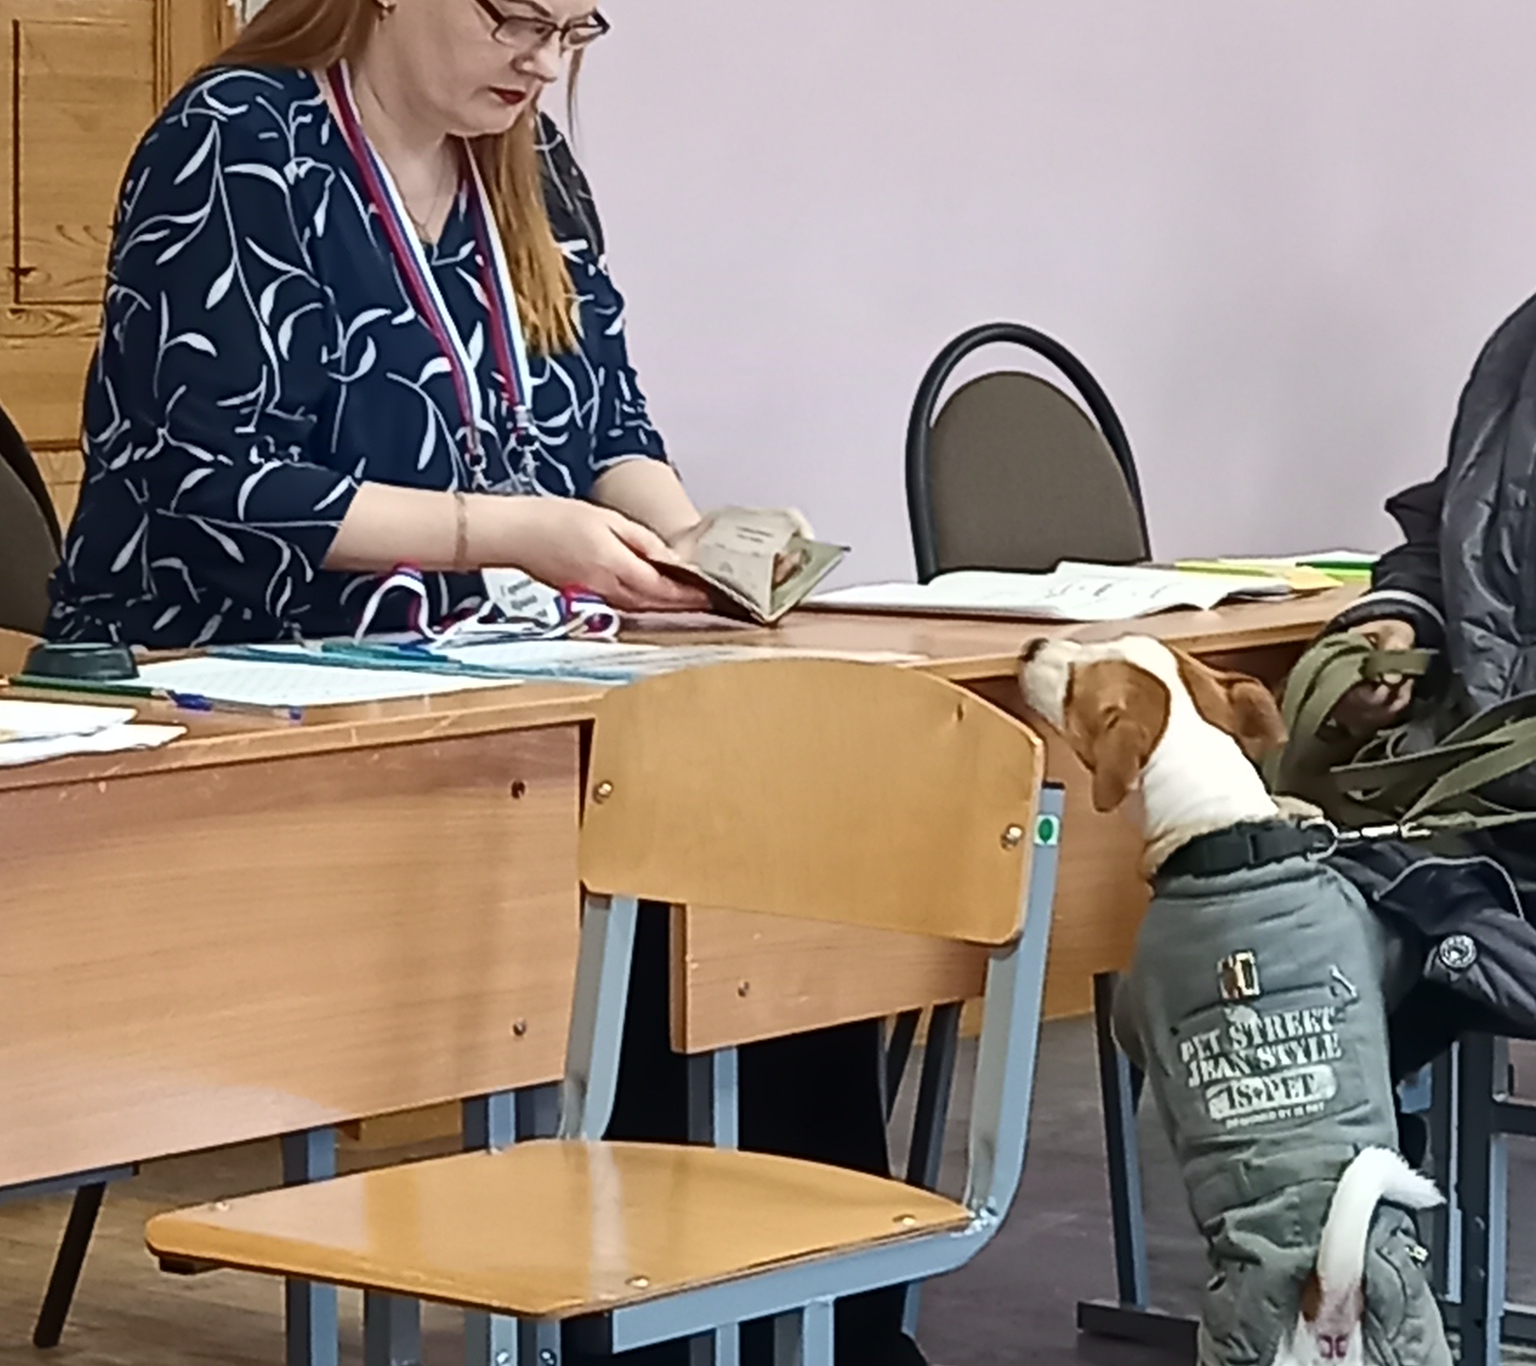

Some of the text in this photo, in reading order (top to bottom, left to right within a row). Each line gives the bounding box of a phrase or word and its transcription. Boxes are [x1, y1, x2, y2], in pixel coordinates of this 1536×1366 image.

[1180, 1006, 1336, 1063] PET STREET
[1188, 1033, 1343, 1088] JEAN STYLE
